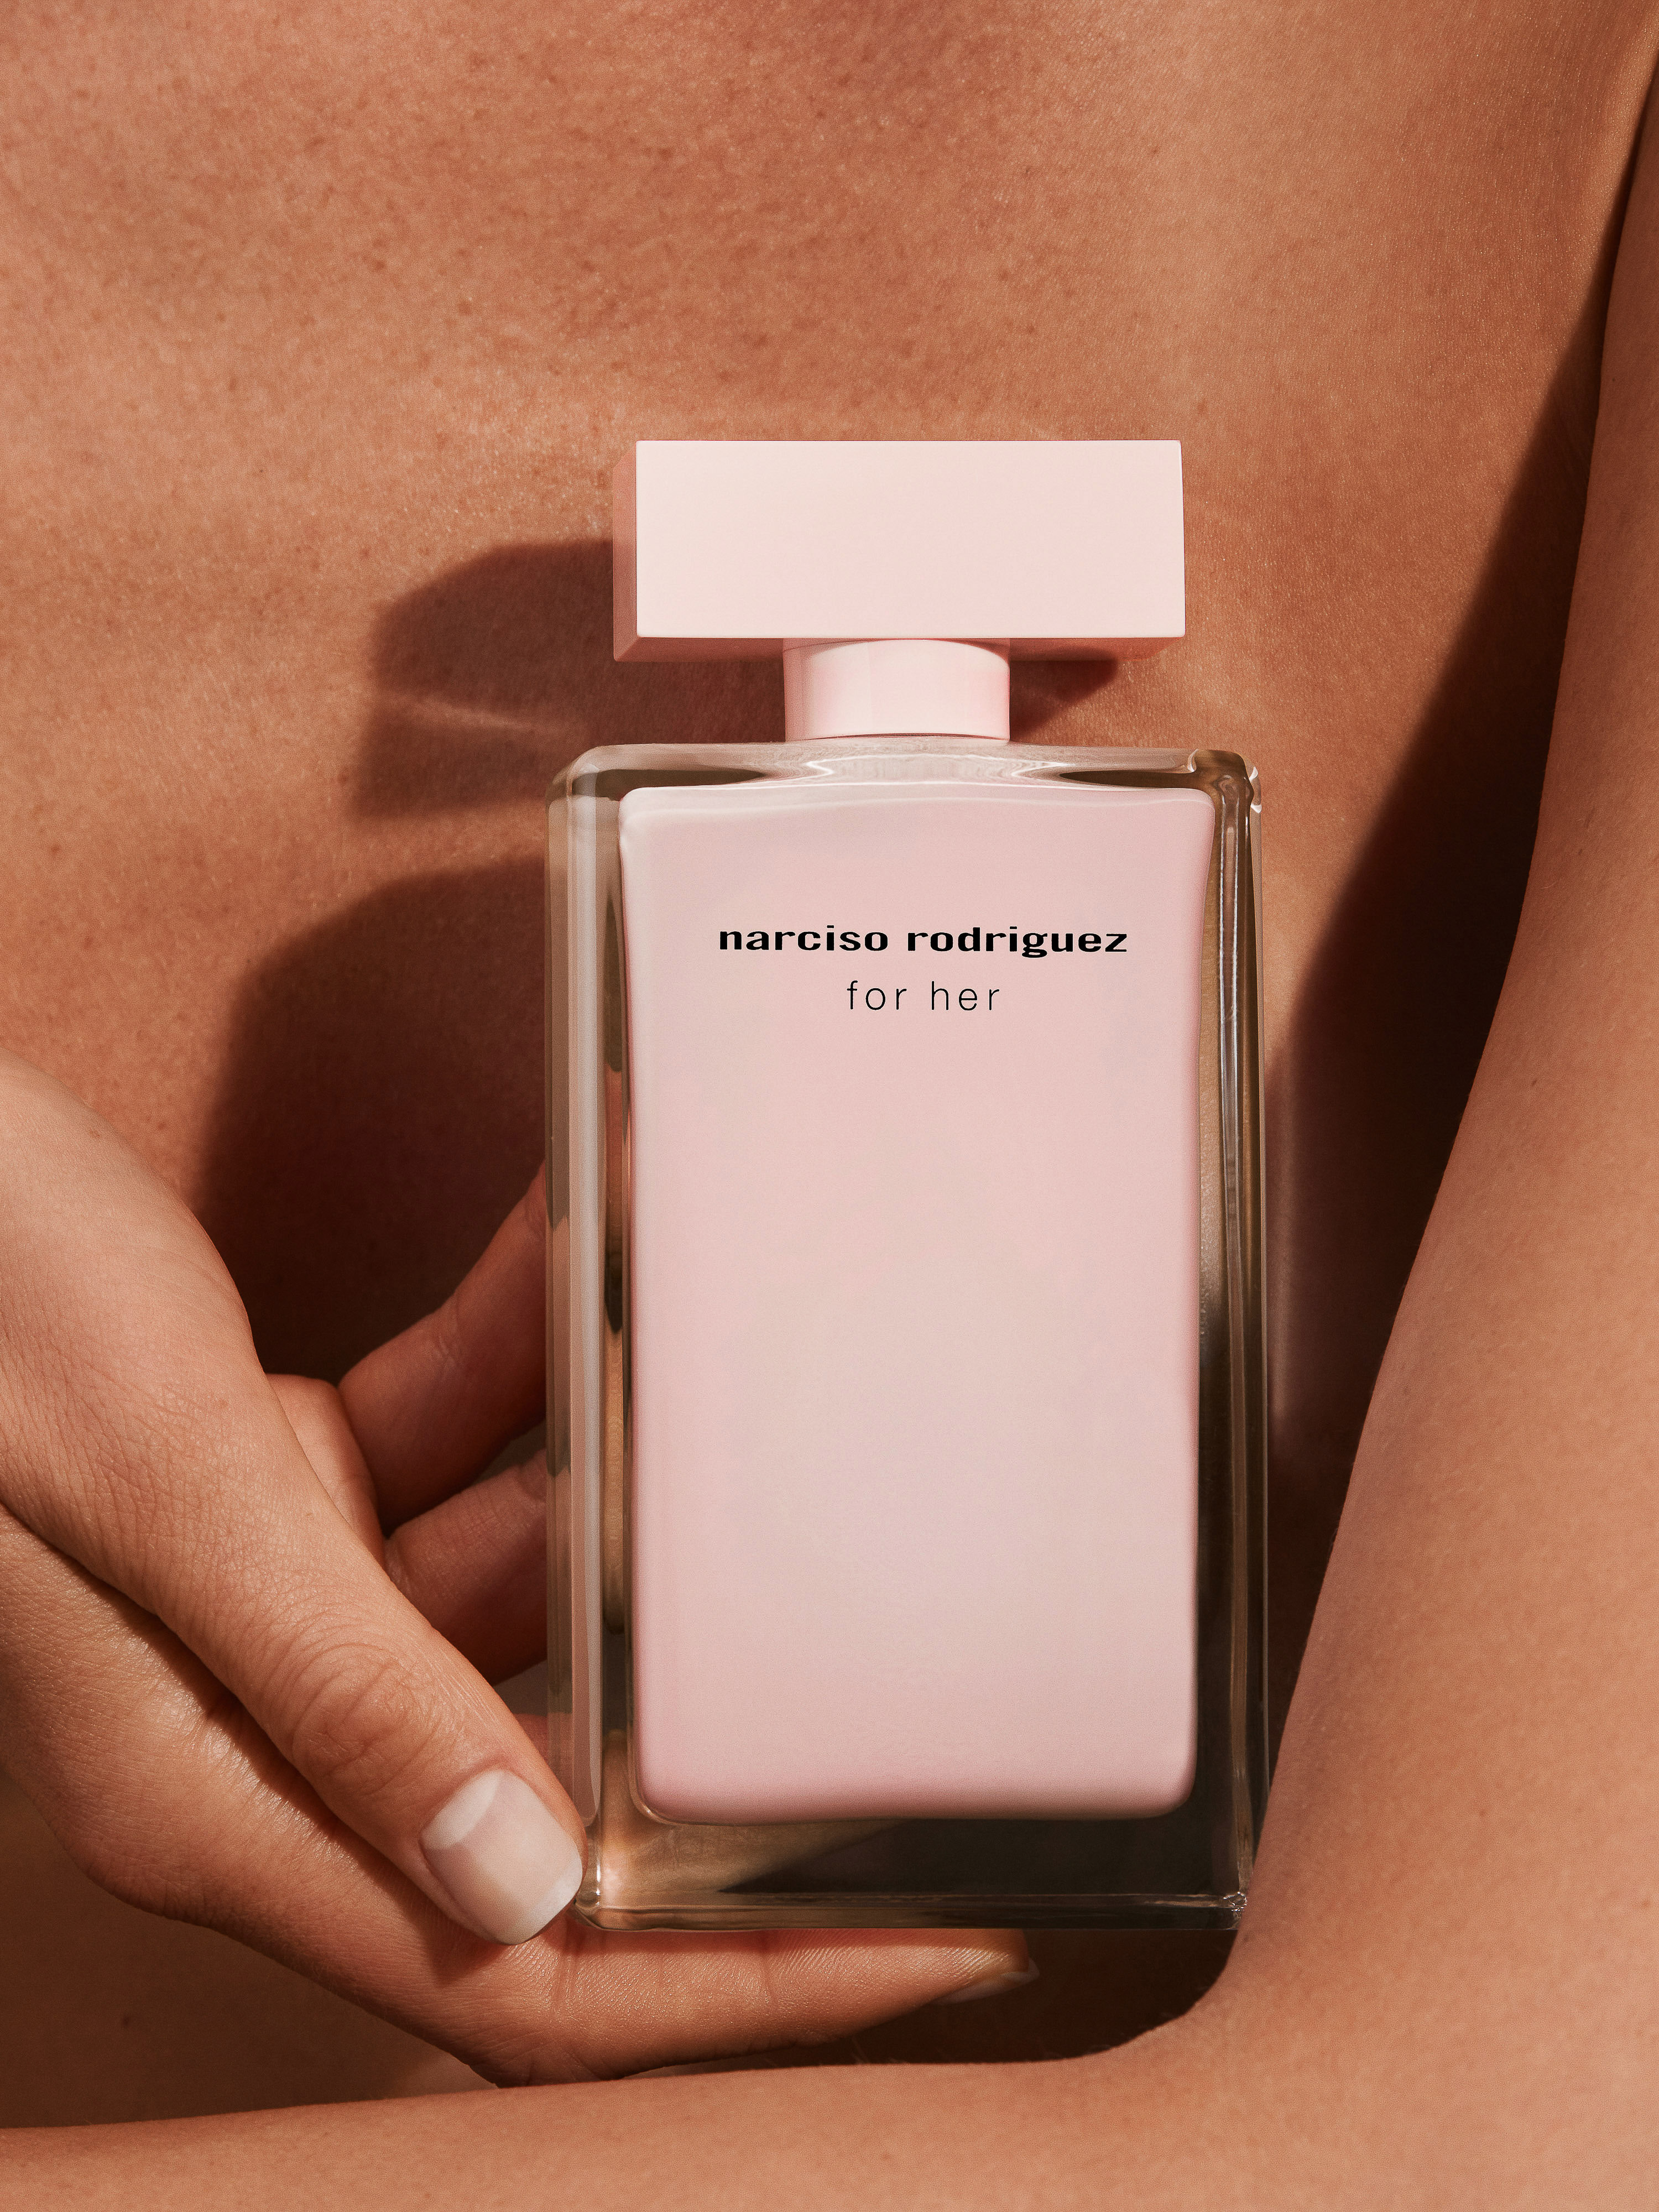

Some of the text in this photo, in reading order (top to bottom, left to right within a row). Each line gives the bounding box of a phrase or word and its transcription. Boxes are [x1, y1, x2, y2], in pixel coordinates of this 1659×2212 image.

[719, 925, 1128, 958] narciso rodriguez
[846, 980, 1000, 1011] for her
